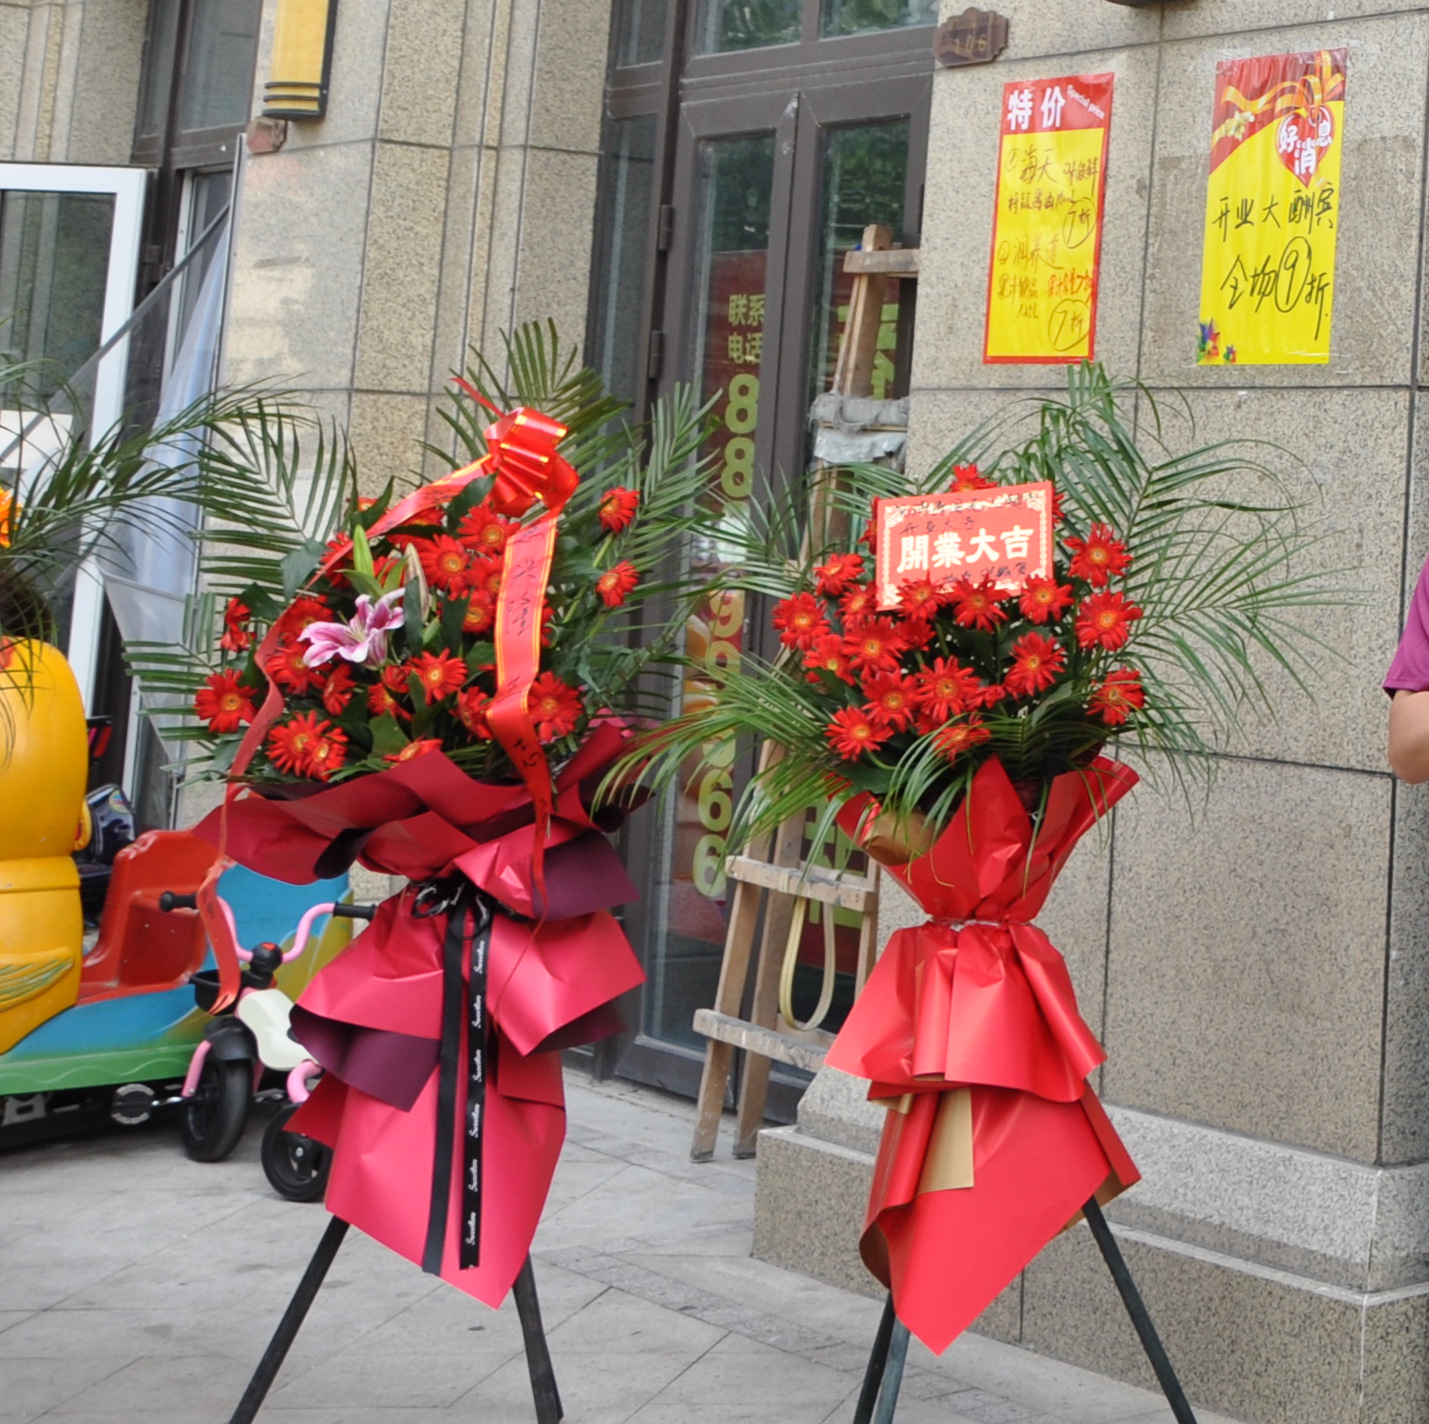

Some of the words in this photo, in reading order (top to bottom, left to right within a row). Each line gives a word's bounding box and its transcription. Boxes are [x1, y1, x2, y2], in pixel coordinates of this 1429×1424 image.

[1007, 86, 1066, 131] 特价
[1278, 120, 1333, 176] 好消息
[1211, 182, 1335, 243] 开业大酬宾
[728, 293, 766, 326] 联系
[728, 332, 765, 364] 电话
[896, 525, 1034, 574] 開業大吉
